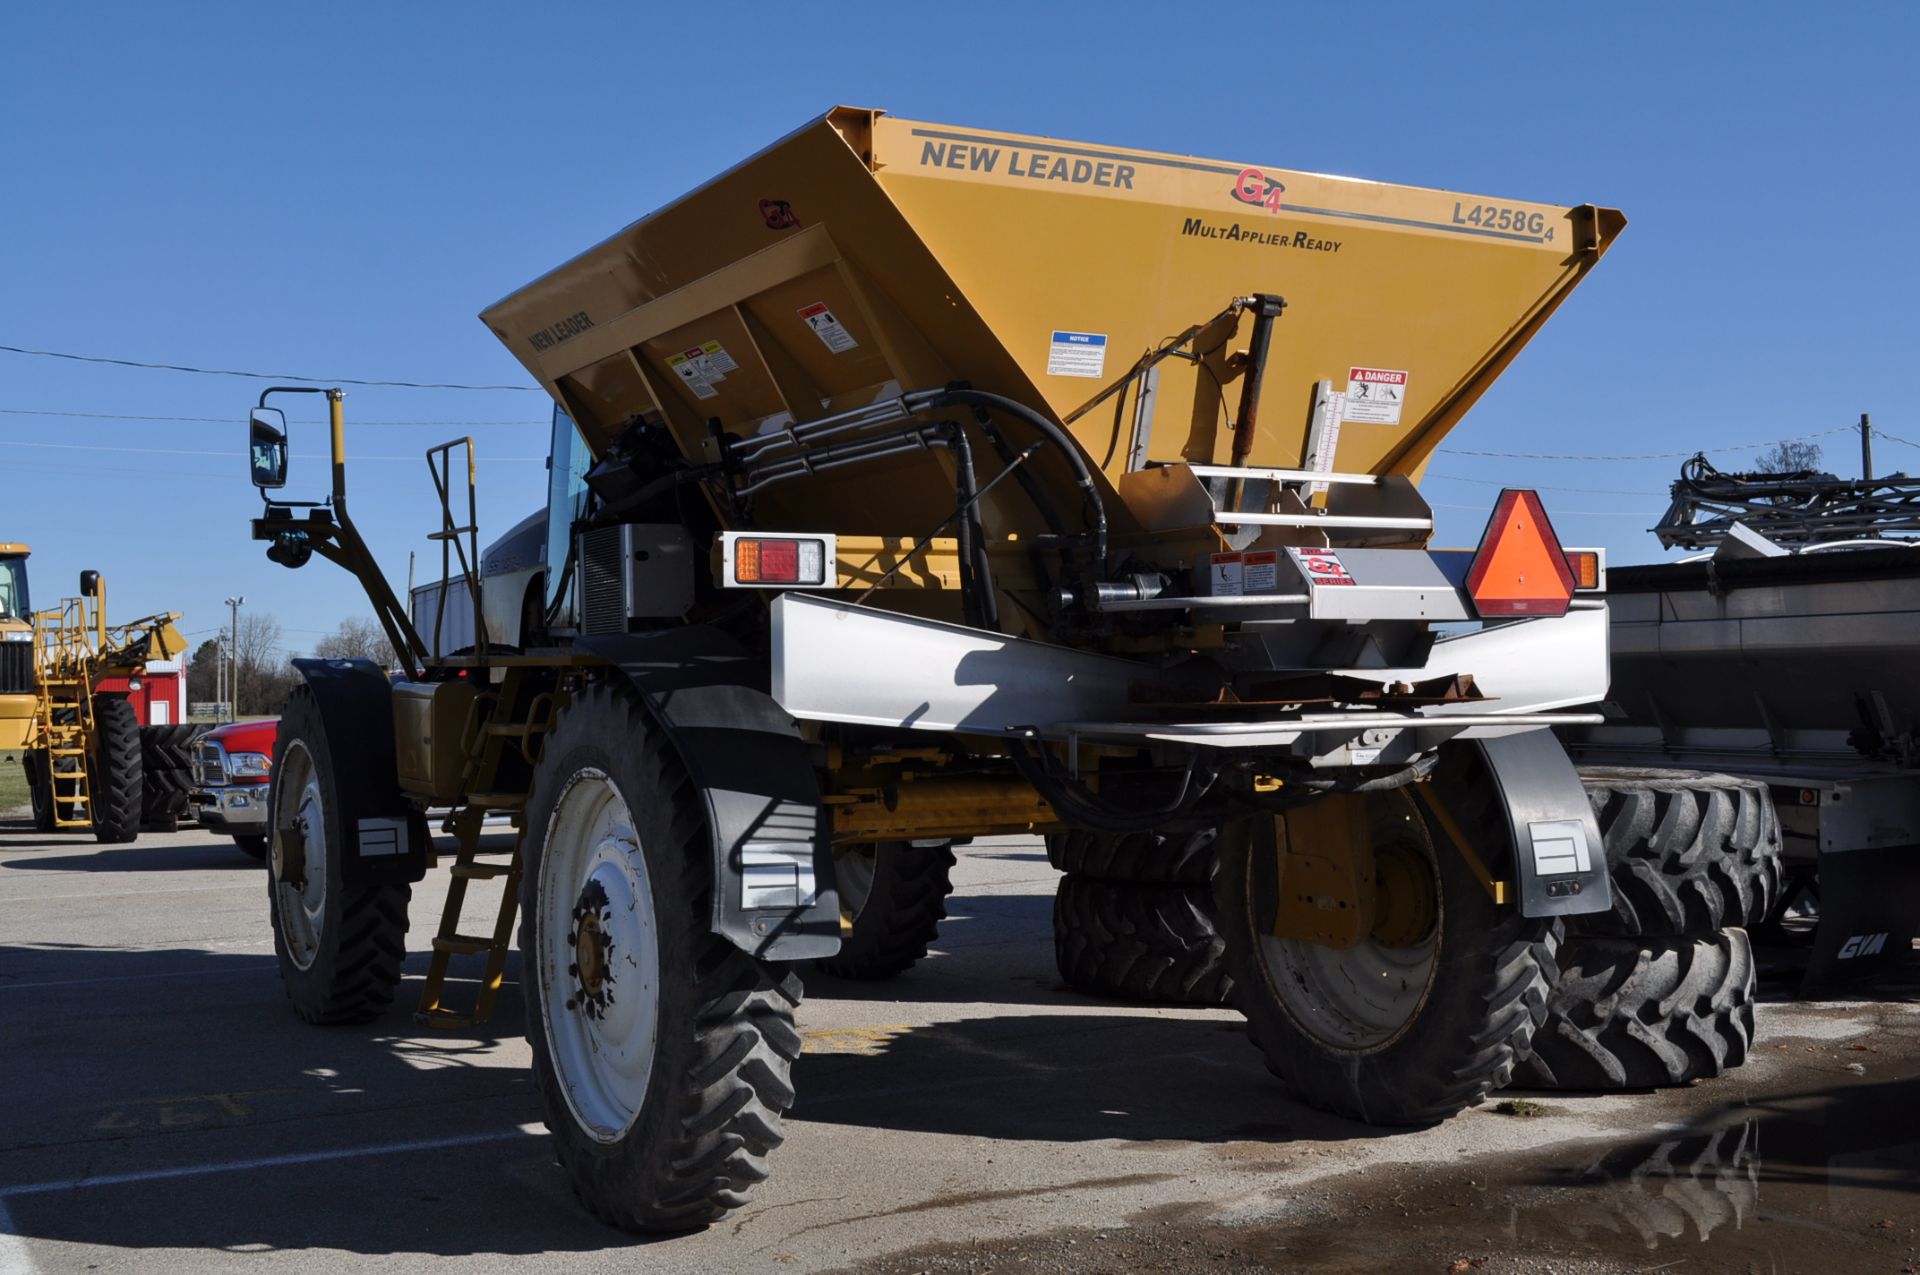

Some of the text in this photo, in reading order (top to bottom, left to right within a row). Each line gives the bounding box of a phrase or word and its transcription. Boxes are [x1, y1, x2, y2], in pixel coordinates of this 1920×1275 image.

[920, 140, 1135, 189] NEW LEADER
[1236, 168, 1281, 215] G4
[528, 311, 595, 352] NEW LEADER
[1364, 371, 1402, 384] DANGER
[1308, 557, 1344, 578] G4
[1314, 577, 1355, 585] SERIES
